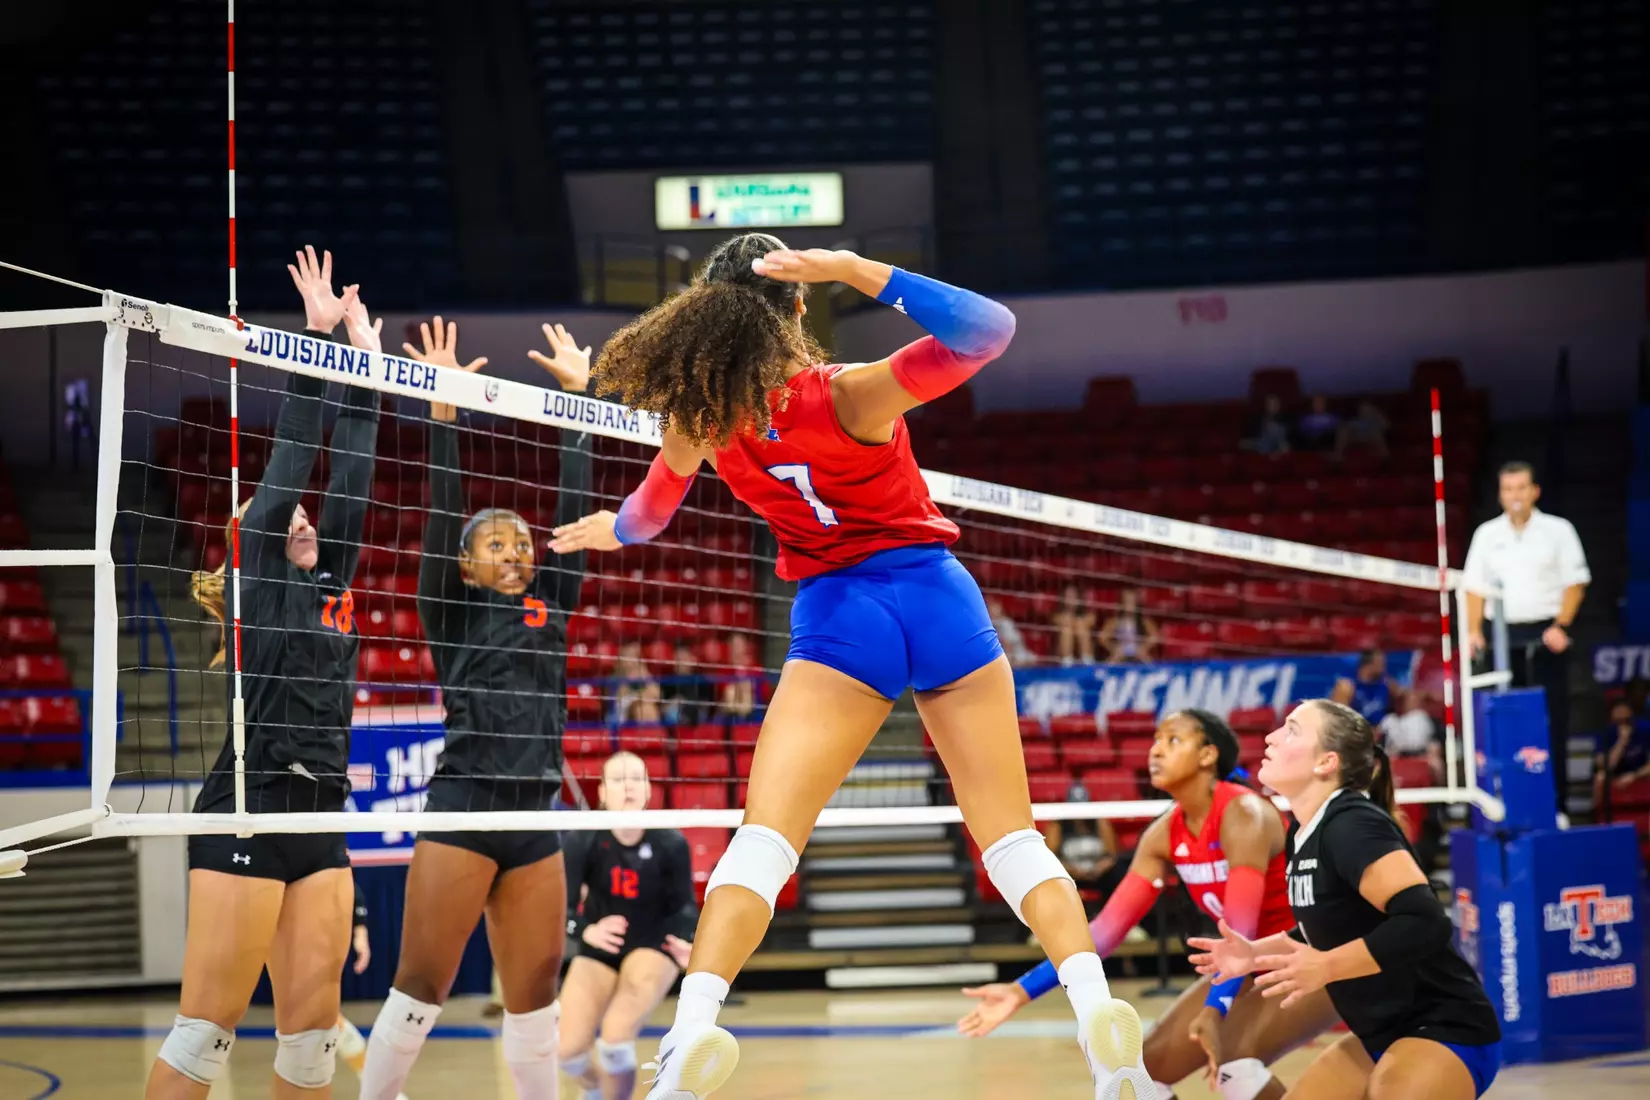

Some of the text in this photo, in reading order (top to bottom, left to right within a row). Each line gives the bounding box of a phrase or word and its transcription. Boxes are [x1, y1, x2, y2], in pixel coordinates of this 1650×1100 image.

[244, 326, 437, 392] LOUISIANA TECH
[543, 392, 641, 434] LOUISIANA
[763, 462, 841, 529] 7
[610, 864, 640, 900] 12
